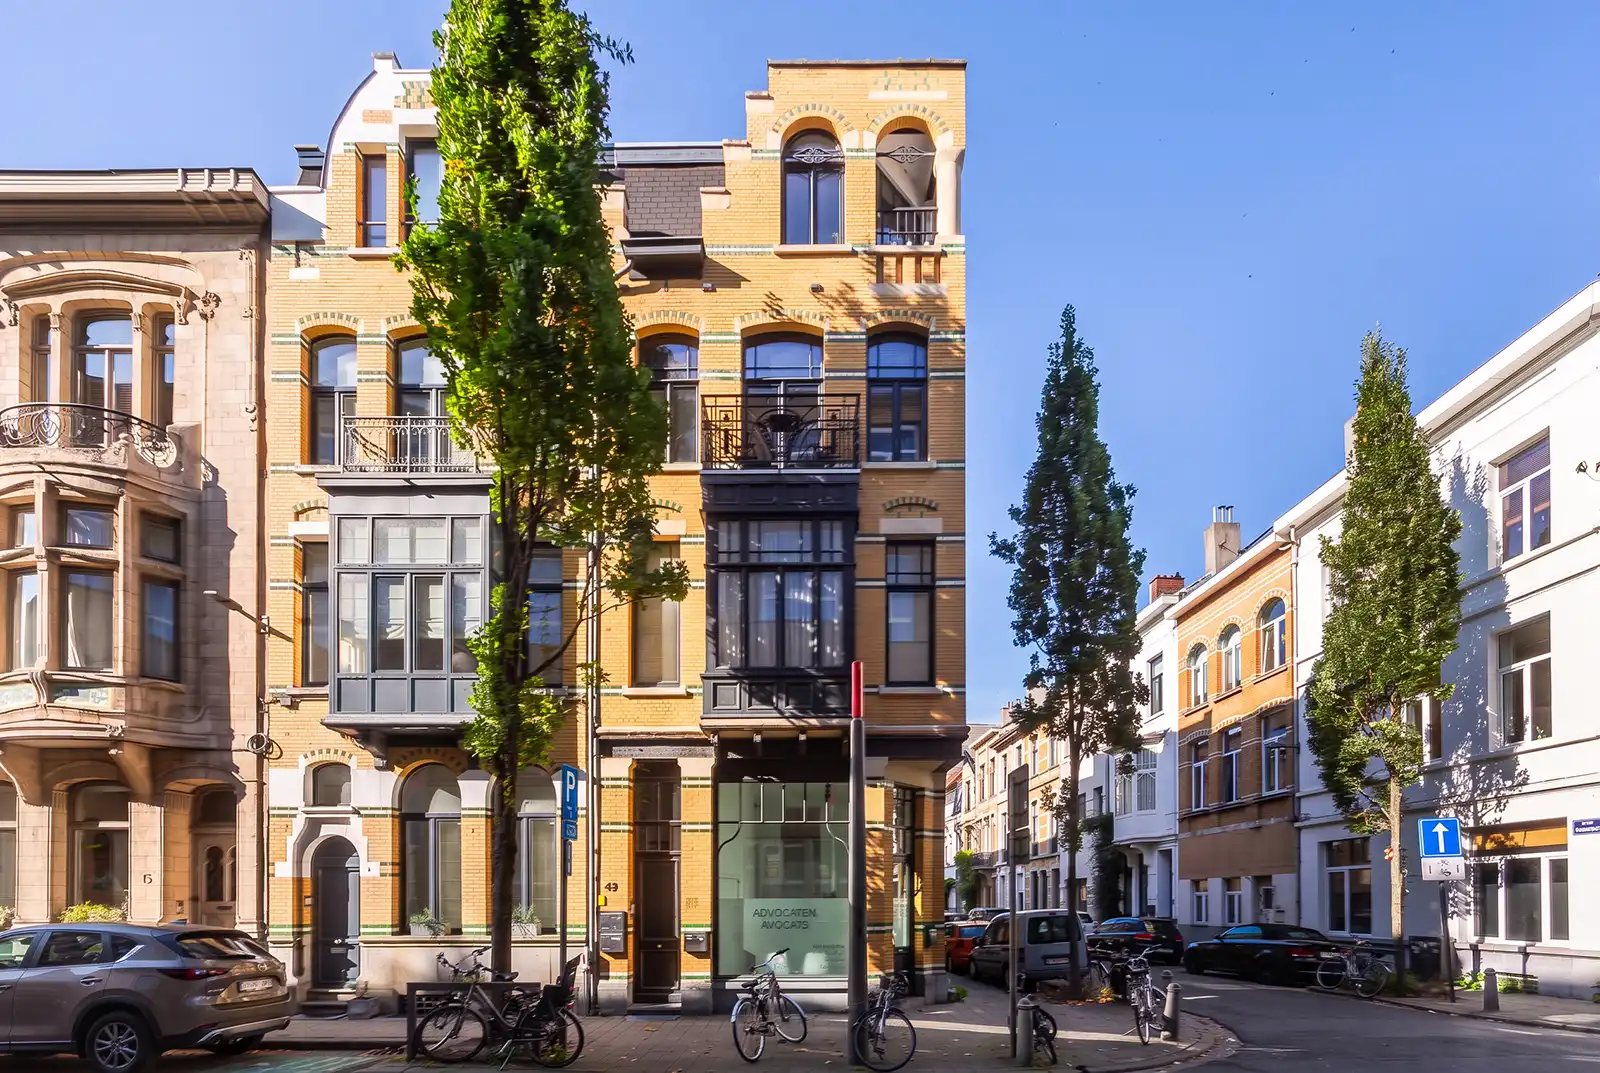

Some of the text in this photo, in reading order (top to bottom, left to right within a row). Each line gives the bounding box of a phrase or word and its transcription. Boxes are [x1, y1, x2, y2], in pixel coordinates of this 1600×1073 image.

[566, 770, 576, 802] P
[752, 908, 817, 918] ADVOCATEN
[760, 920, 809, 930] AVOCATS
